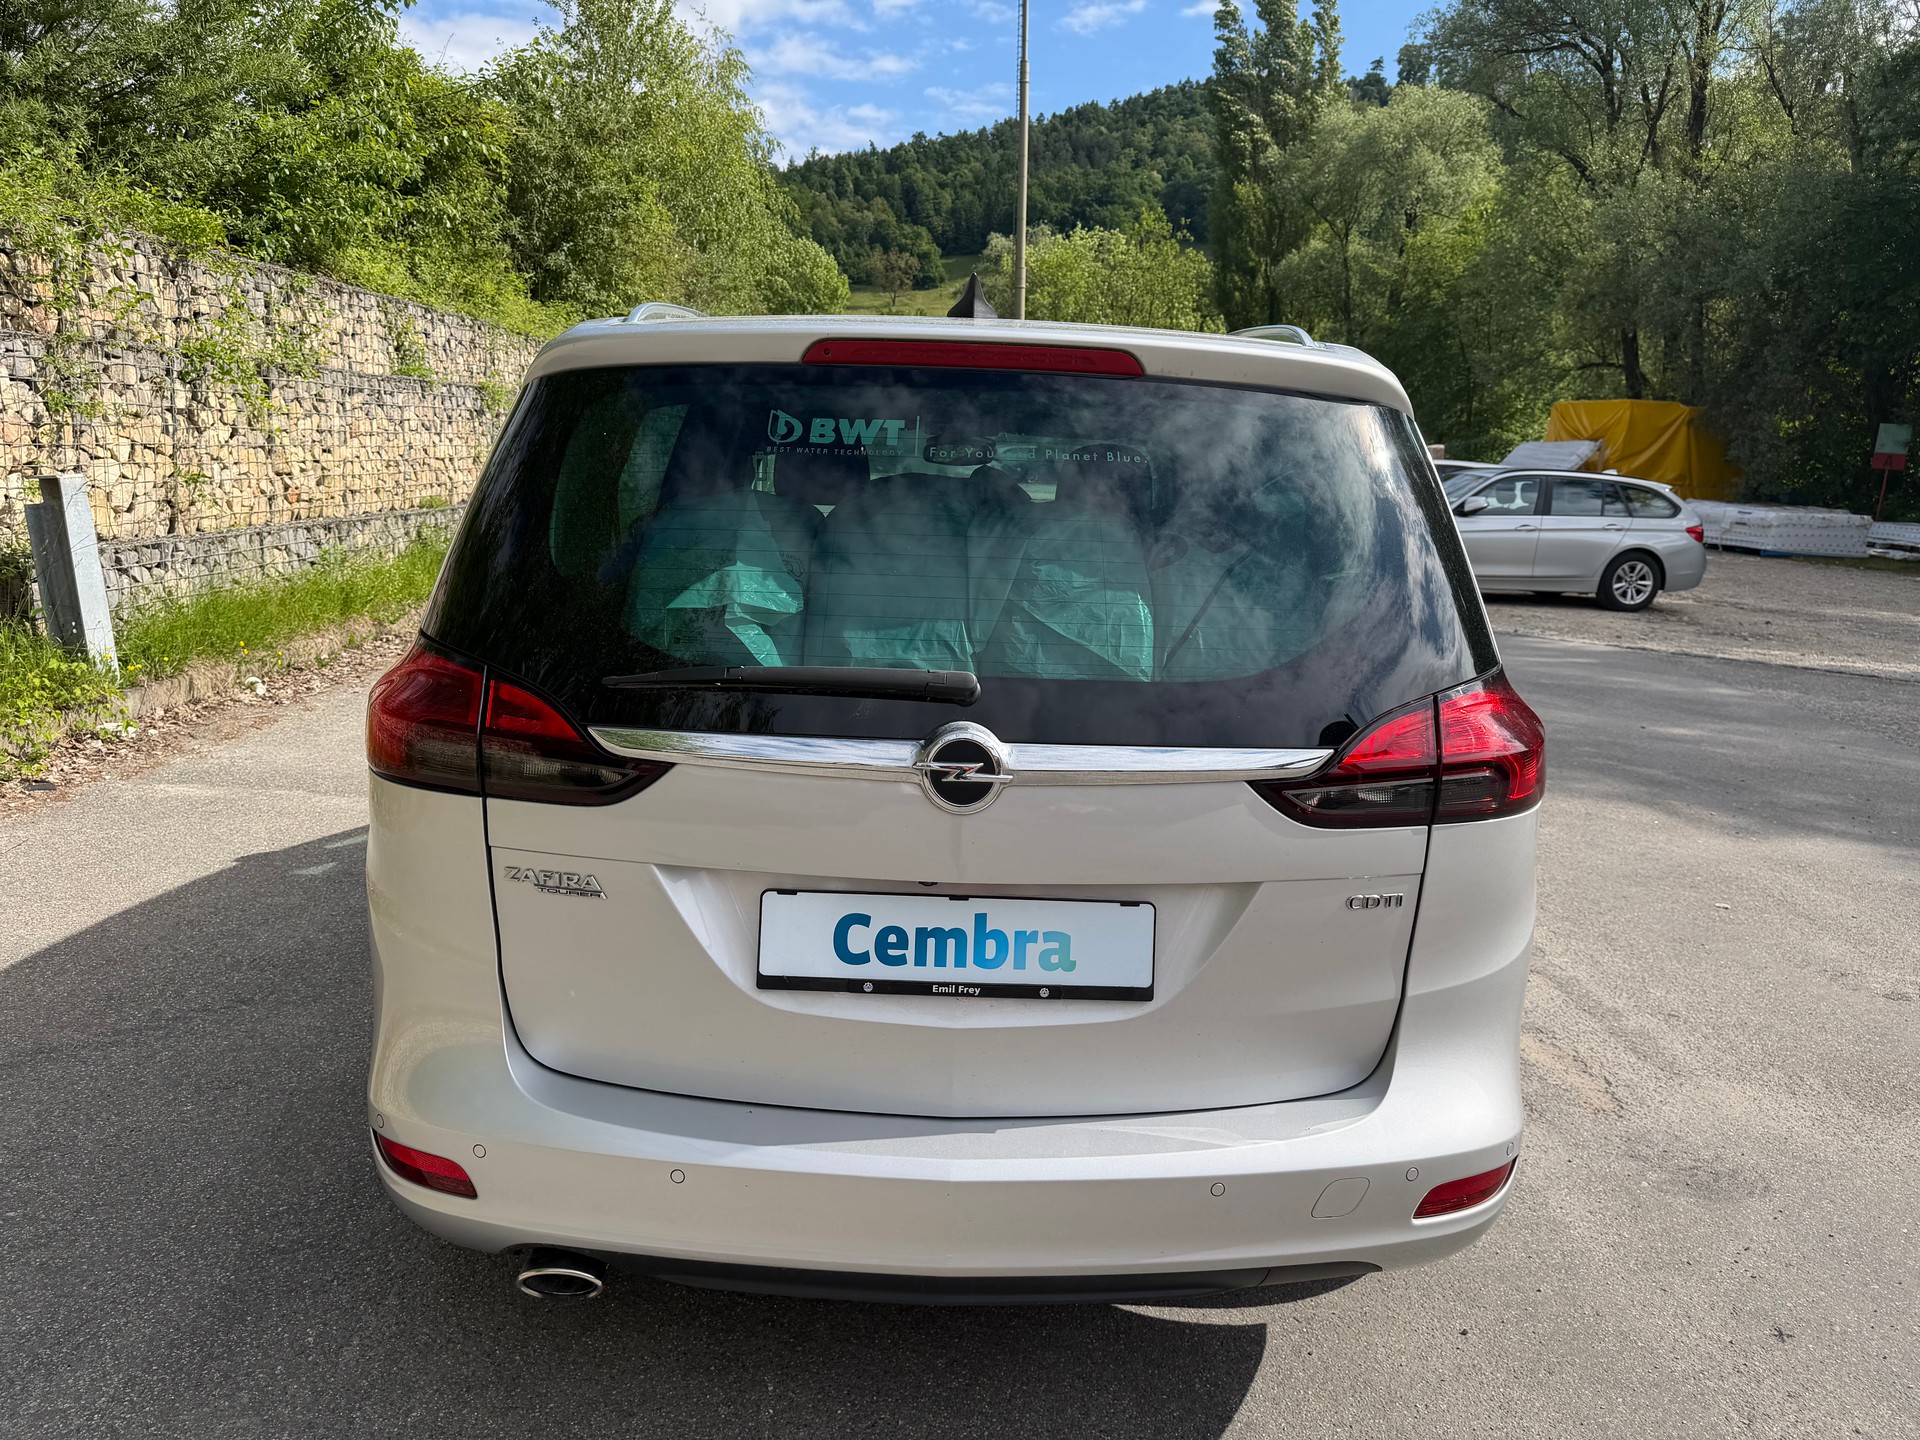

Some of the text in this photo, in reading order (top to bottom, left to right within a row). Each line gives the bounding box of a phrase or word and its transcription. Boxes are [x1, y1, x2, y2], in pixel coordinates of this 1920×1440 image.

[809, 417, 906, 446] BWT
[796, 447, 828, 455] WATER
[834, 448, 903, 456] TECHNOLOGY
[929, 446, 956, 458] For
[965, 447, 995, 458] You
[1045, 448, 1098, 461] Planet
[1106, 450, 1148, 463] Blue.
[503, 866, 605, 892] ZAFIRA
[540, 887, 602, 899] TOURER
[1345, 892, 1404, 910] CDTI
[832, 912, 1077, 973] Cembra
[932, 984, 981, 996] Emil Frey
